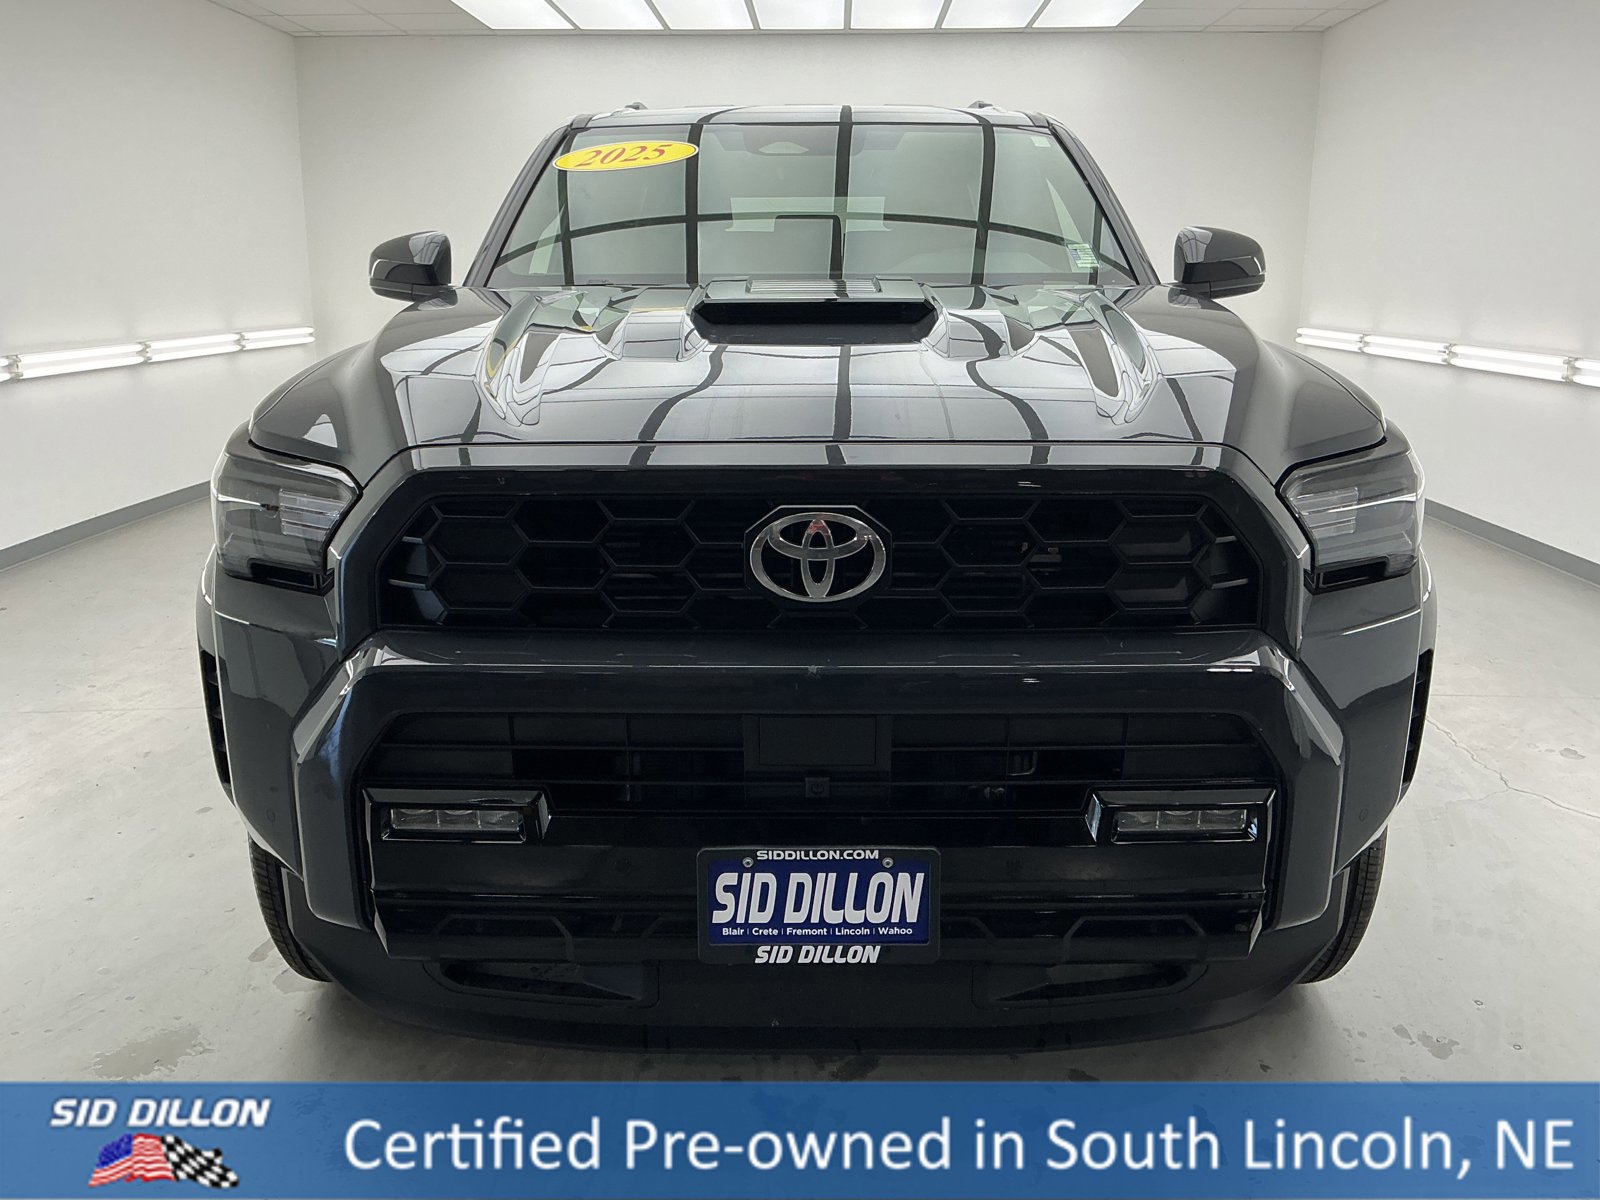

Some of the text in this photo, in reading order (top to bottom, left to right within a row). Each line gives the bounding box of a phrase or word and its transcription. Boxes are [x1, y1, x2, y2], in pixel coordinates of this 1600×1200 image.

[574, 143, 672, 167] 2025
[757, 850, 879, 860] SIDDILLON.COM
[712, 872, 925, 924] SID DILLON
[722, 926, 912, 936] Blair Crete Fremont Lincoln Wahoo
[755, 946, 881, 964] SID DILLON
